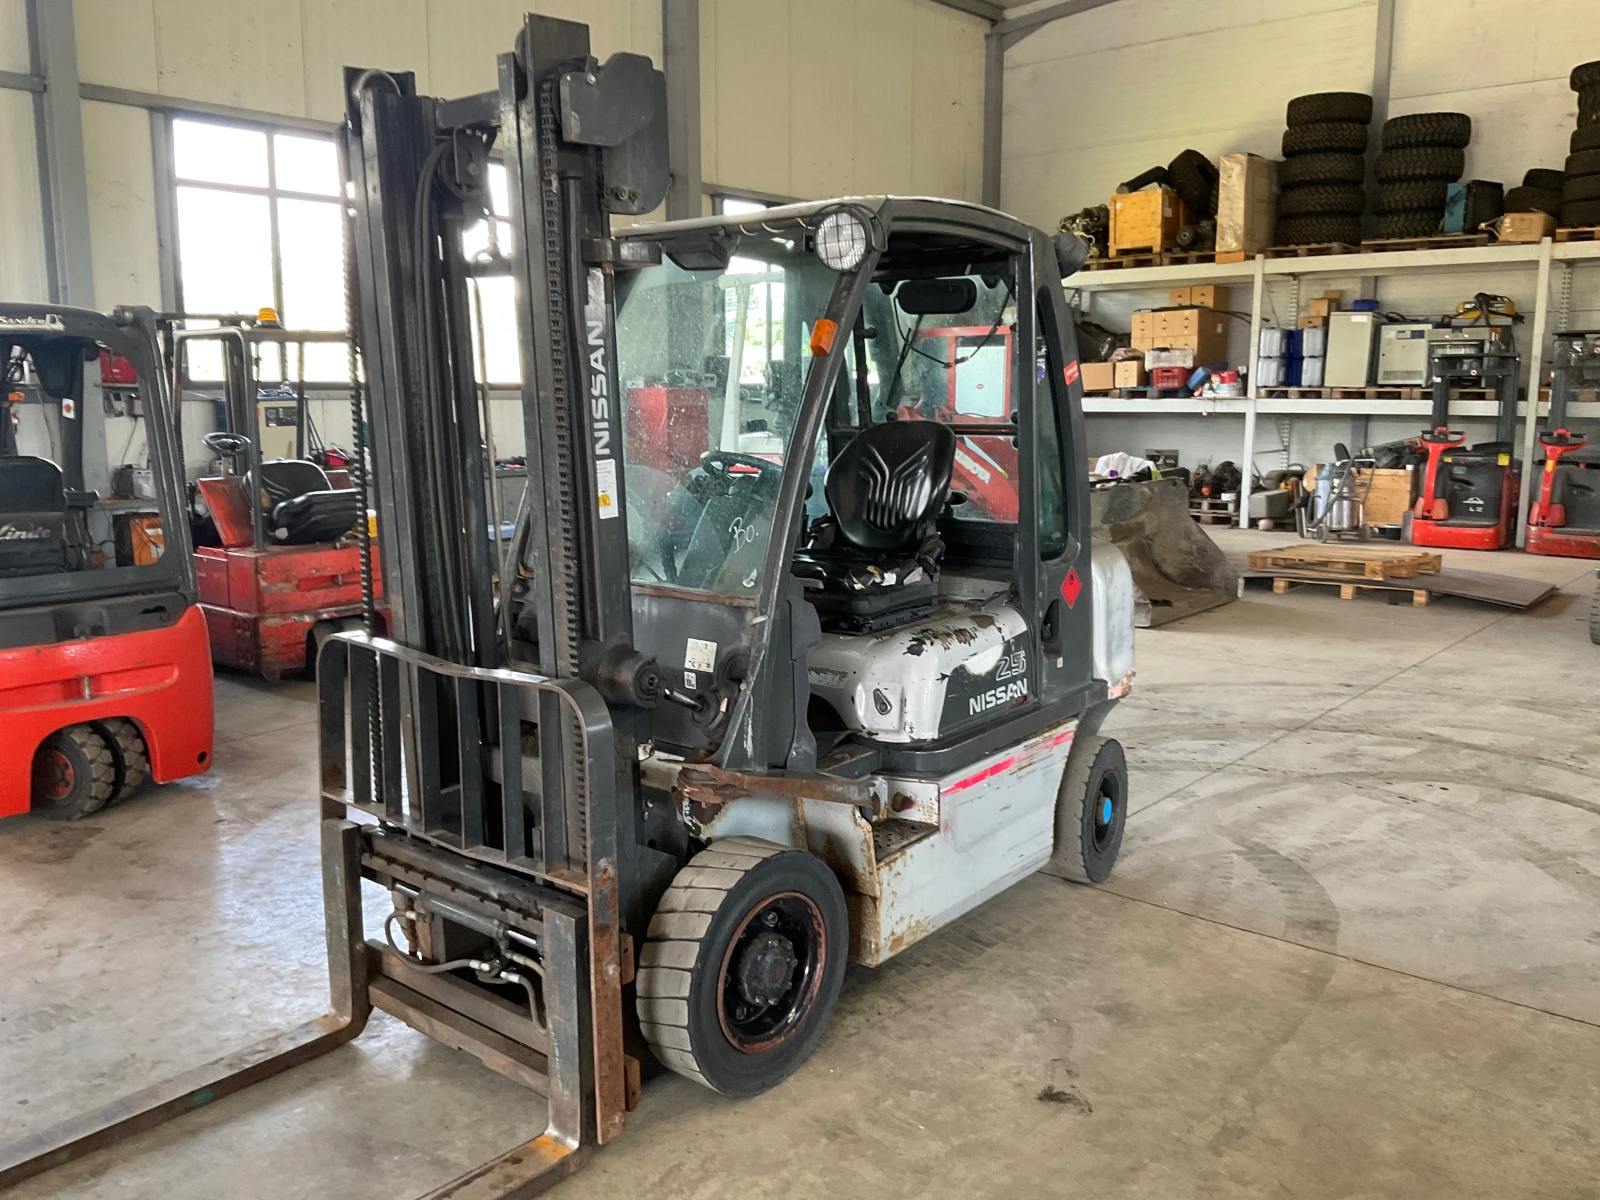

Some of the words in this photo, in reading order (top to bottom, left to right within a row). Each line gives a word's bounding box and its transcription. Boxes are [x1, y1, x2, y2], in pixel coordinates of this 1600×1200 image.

[587, 320, 609, 455] NISSAN
[996, 650, 1026, 681] 25
[969, 678, 1027, 715] NISSAN
